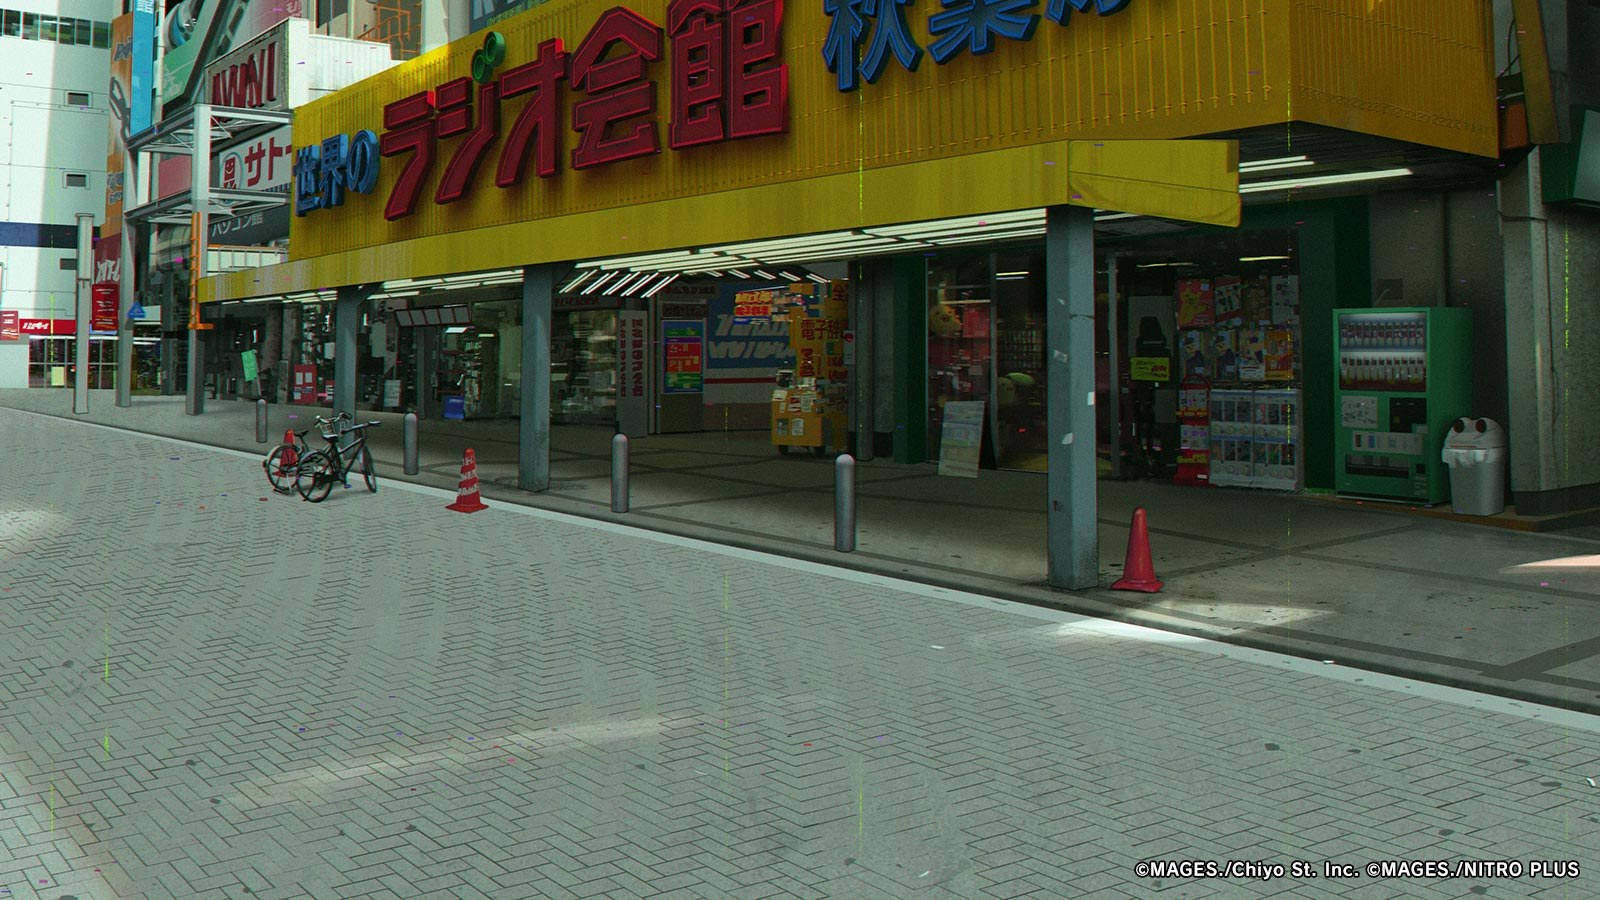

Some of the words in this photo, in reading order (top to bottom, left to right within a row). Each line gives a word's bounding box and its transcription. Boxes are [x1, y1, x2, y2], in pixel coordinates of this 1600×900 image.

[293, 129, 380, 217] 世界の
[381, 0, 789, 220] ラジオ会館
[822, 0, 1132, 92] 秋葉
